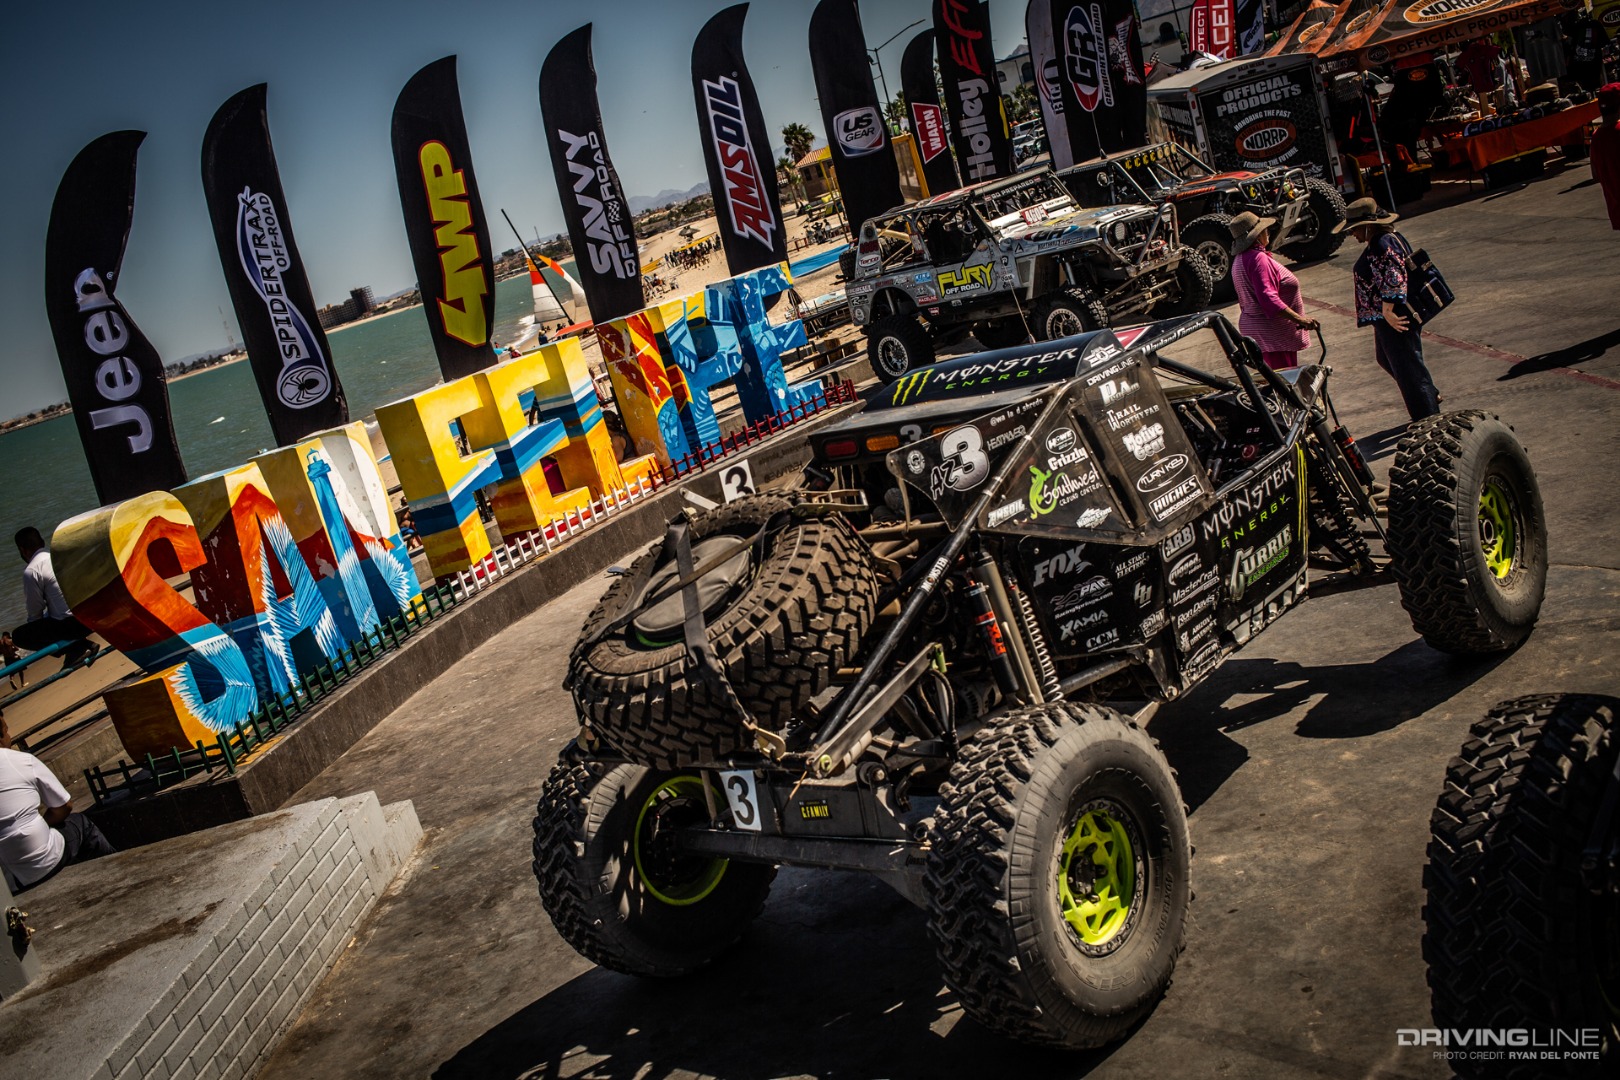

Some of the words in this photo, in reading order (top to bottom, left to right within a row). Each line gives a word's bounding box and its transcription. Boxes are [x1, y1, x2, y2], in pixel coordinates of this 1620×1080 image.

[1396, 27, 1464, 54] OFFICIAL
[1467, 3, 1550, 33] PRODUCTS
[1068, 29, 1099, 88] GR
[1216, 83, 1302, 118] PRODUCTS
[1222, 75, 1292, 103] OFFICIAL
[843, 113, 873, 133] US
[845, 127, 876, 143] GEAR
[922, 108, 943, 151] WARN
[958, 78, 997, 180] Holley
[1233, 111, 1263, 132] HONORING
[1263, 109, 1276, 117] THE
[1275, 109, 1292, 118] PAST
[1245, 128, 1287, 149] NORRA
[587, 131, 616, 202] ROAD
[702, 75, 777, 252] AMSOIL
[1268, 158, 1279, 167] THE
[1278, 146, 1299, 163] FUTURE
[558, 128, 626, 280] SAVVY
[260, 195, 288, 269] OFF-ROAD
[418, 140, 488, 349] 4WP
[245, 196, 301, 361] SPIDERTRAX
[937, 261, 996, 299] FURY
[945, 287, 959, 295] OFF
[960, 282, 981, 292] ROAD
[73, 266, 155, 455] Jeep
[945, 366, 1049, 391] ENERGY
[1106, 403, 1141, 422] TRAIL
[1122, 422, 1165, 453] Motive
[1133, 436, 1166, 461] Gear
[939, 424, 991, 492] 3
[1048, 446, 1089, 471] Grizzly
[1042, 463, 1101, 506] Southwest
[1059, 492, 1080, 507] GROUND
[1079, 482, 1104, 499] CONTROL
[1153, 480, 1197, 513] HUGHES
[1202, 460, 1296, 541] MONSTER
[51, 420, 423, 761] SAN
[375, 264, 825, 578] FELIPE
[1157, 489, 1202, 522] PERFORMANCE
[1220, 494, 1287, 550] ENERGY
[1165, 526, 1193, 554] ARB
[1033, 543, 1089, 588] FOX
[1115, 562, 1128, 573] ALL
[1127, 551, 1147, 566] START
[1116, 558, 1147, 580] ELECTRIC
[1230, 522, 1293, 602] CURRIE
[1080, 578, 1113, 599] PAC
[1172, 563, 1219, 604] MasterCraft
[1177, 606, 1193, 628] Ron
[1086, 627, 1119, 649] CCM
[728, 775, 755, 826] 3
